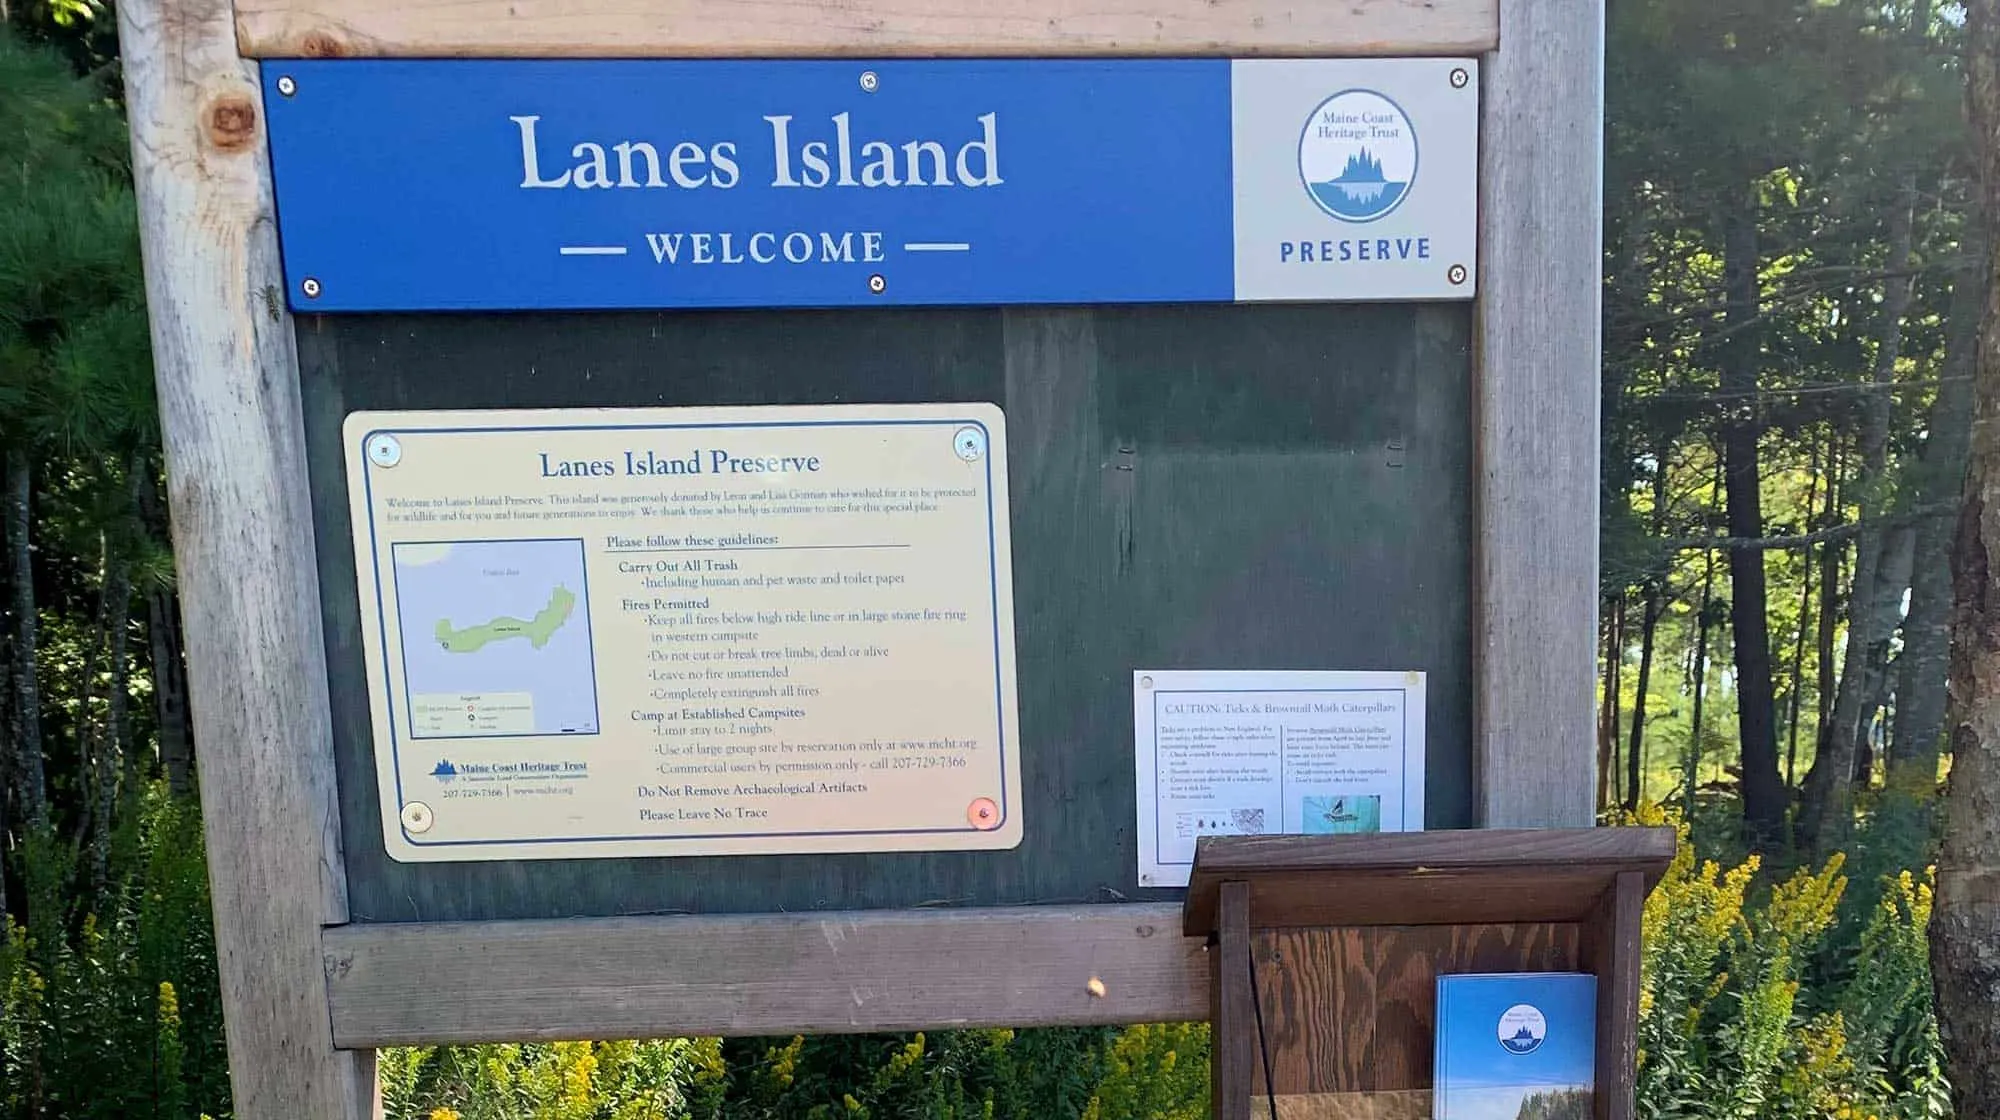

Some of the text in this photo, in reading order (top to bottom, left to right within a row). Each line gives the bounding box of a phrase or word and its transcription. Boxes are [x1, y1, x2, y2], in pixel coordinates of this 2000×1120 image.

[1323, 112, 1393, 124] Maine Coast
[1318, 126, 1399, 140] Heritage Trust
[509, 111, 1004, 190] Lanes Island
[645, 231, 886, 265] WELCOME
[1280, 238, 1430, 263] PRESERVE
[538, 450, 821, 478] Lanes Island Preserve
[386, 497, 432, 508] Welcome
[432, 498, 442, 507] to
[445, 496, 470, 506] Lanes
[474, 495, 501, 506] Island
[548, 494, 569, 505] This
[572, 493, 598, 504] island
[602, 496, 617, 504] was
[620, 492, 667, 506] generously
[670, 491, 706, 502] donated
[709, 491, 720, 505] by
[749, 490, 767, 501] and
[769, 490, 786, 500] Lisa
[830, 489, 848, 499] who
[851, 488, 882, 499] wished
[884, 488, 896, 498] for
[909, 489, 918, 498] to
[934, 486, 976, 500] protected
[386, 511, 398, 521] for
[403, 510, 435, 521] wildlife
[439, 510, 456, 520] and
[458, 510, 470, 520] for
[474, 512, 490, 522] you
[494, 509, 510, 519] and
[512, 508, 538, 519] future
[542, 508, 595, 521] generations
[598, 508, 608, 517] to
[640, 506, 657, 516] We
[660, 505, 684, 516] thank
[689, 505, 713, 515] those
[716, 504, 735, 514] who
[738, 504, 757, 517] help
[772, 504, 811, 513] continue
[814, 504, 824, 512] to
[848, 502, 860, 512] for
[863, 501, 880, 511] this
[882, 501, 912, 514] special
[606, 533, 779, 548] Please follow these guidelines:
[618, 559, 738, 575] Carry Out All Trash
[701, 575, 739, 586] human
[742, 574, 762, 586] and
[766, 576, 782, 588] pet
[786, 575, 817, 585] waste
[820, 573, 840, 584] and
[844, 572, 874, 583] toilet
[876, 574, 904, 586] paper
[622, 597, 709, 609] Fires Permitted
[680, 613, 692, 624] all
[696, 612, 719, 624] fires
[722, 612, 753, 623] below
[756, 611, 781, 626] high
[810, 610, 830, 621] line
[833, 613, 844, 621] or
[848, 611, 858, 621] in
[862, 609, 888, 624] large
[890, 610, 920, 620] stone
[924, 608, 940, 619] fire
[944, 609, 966, 622] ring
[652, 630, 758, 643] in western campsite
[671, 651, 688, 660] not
[692, 650, 710, 660] cut
[728, 648, 756, 659] break
[760, 649, 780, 658] tree
[784, 647, 817, 659] limbs,
[820, 646, 846, 657] dead
[863, 645, 888, 656] alive
[688, 671, 702, 679] no
[705, 667, 722, 679] fire
[726, 666, 788, 678] unattended
[720, 685, 776, 701] extinguish
[780, 685, 793, 696] all
[796, 684, 819, 696] fires
[630, 706, 805, 723] Camp at Established Campsites
[1165, 702, 1396, 716] CAUTION: Ticks & Browntail Moth Caterpillars
[690, 725, 710, 738] stay
[714, 725, 725, 734] to
[728, 723, 735, 734] 2
[738, 722, 772, 737] nights
[682, 743, 692, 754] of
[696, 743, 721, 757] large
[725, 745, 756, 756] group
[759, 742, 778, 752] site
[781, 741, 792, 755] by
[797, 741, 855, 751] reservation
[859, 739, 882, 754] only
[886, 740, 896, 749] at
[460, 762, 586, 774] Maine Coast Heritage Trust
[730, 764, 755, 772] users
[759, 760, 770, 775] by
[776, 760, 831, 774] permission
[834, 759, 858, 773] only
[869, 758, 888, 769] call
[892, 756, 966, 768] 207-729-7366
[638, 781, 867, 798] Do Not Remove Archaeological Artifacts
[639, 806, 768, 820] Please Leave No Trace
